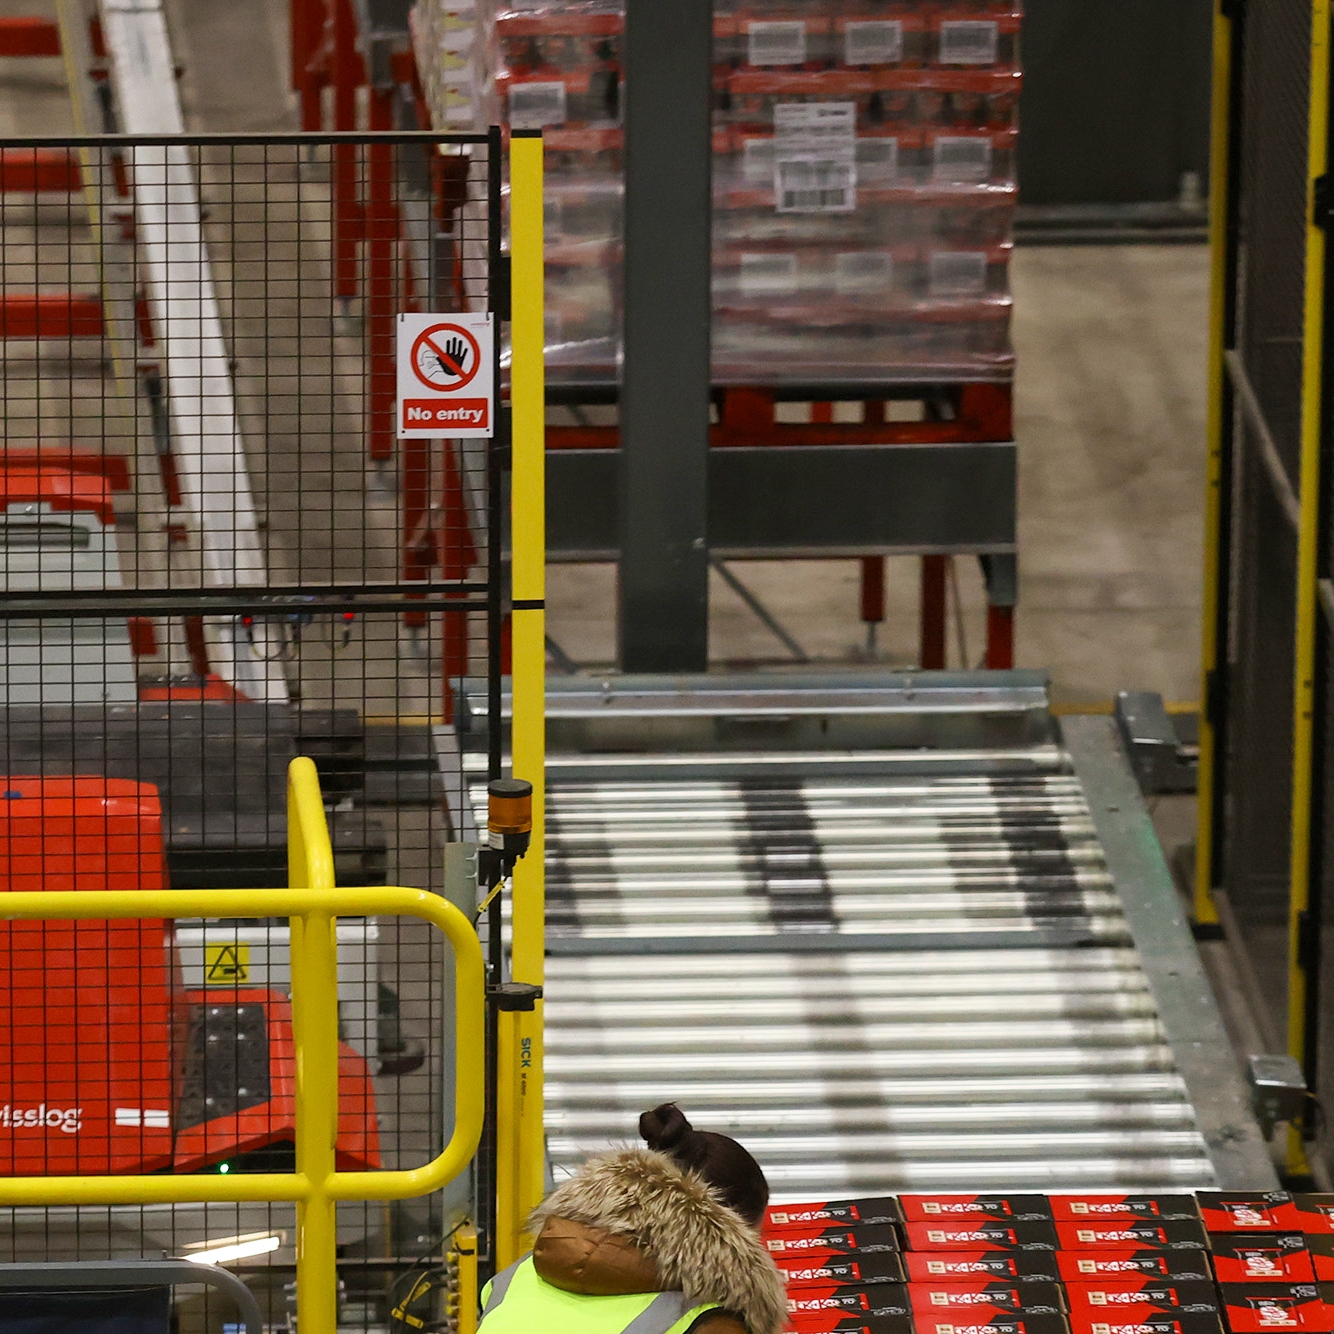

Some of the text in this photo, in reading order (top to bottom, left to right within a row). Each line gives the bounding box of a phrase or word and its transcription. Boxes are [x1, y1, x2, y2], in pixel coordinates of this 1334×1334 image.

[408, 407, 484, 423] No entry
[521, 1037, 531, 1067] SICK
